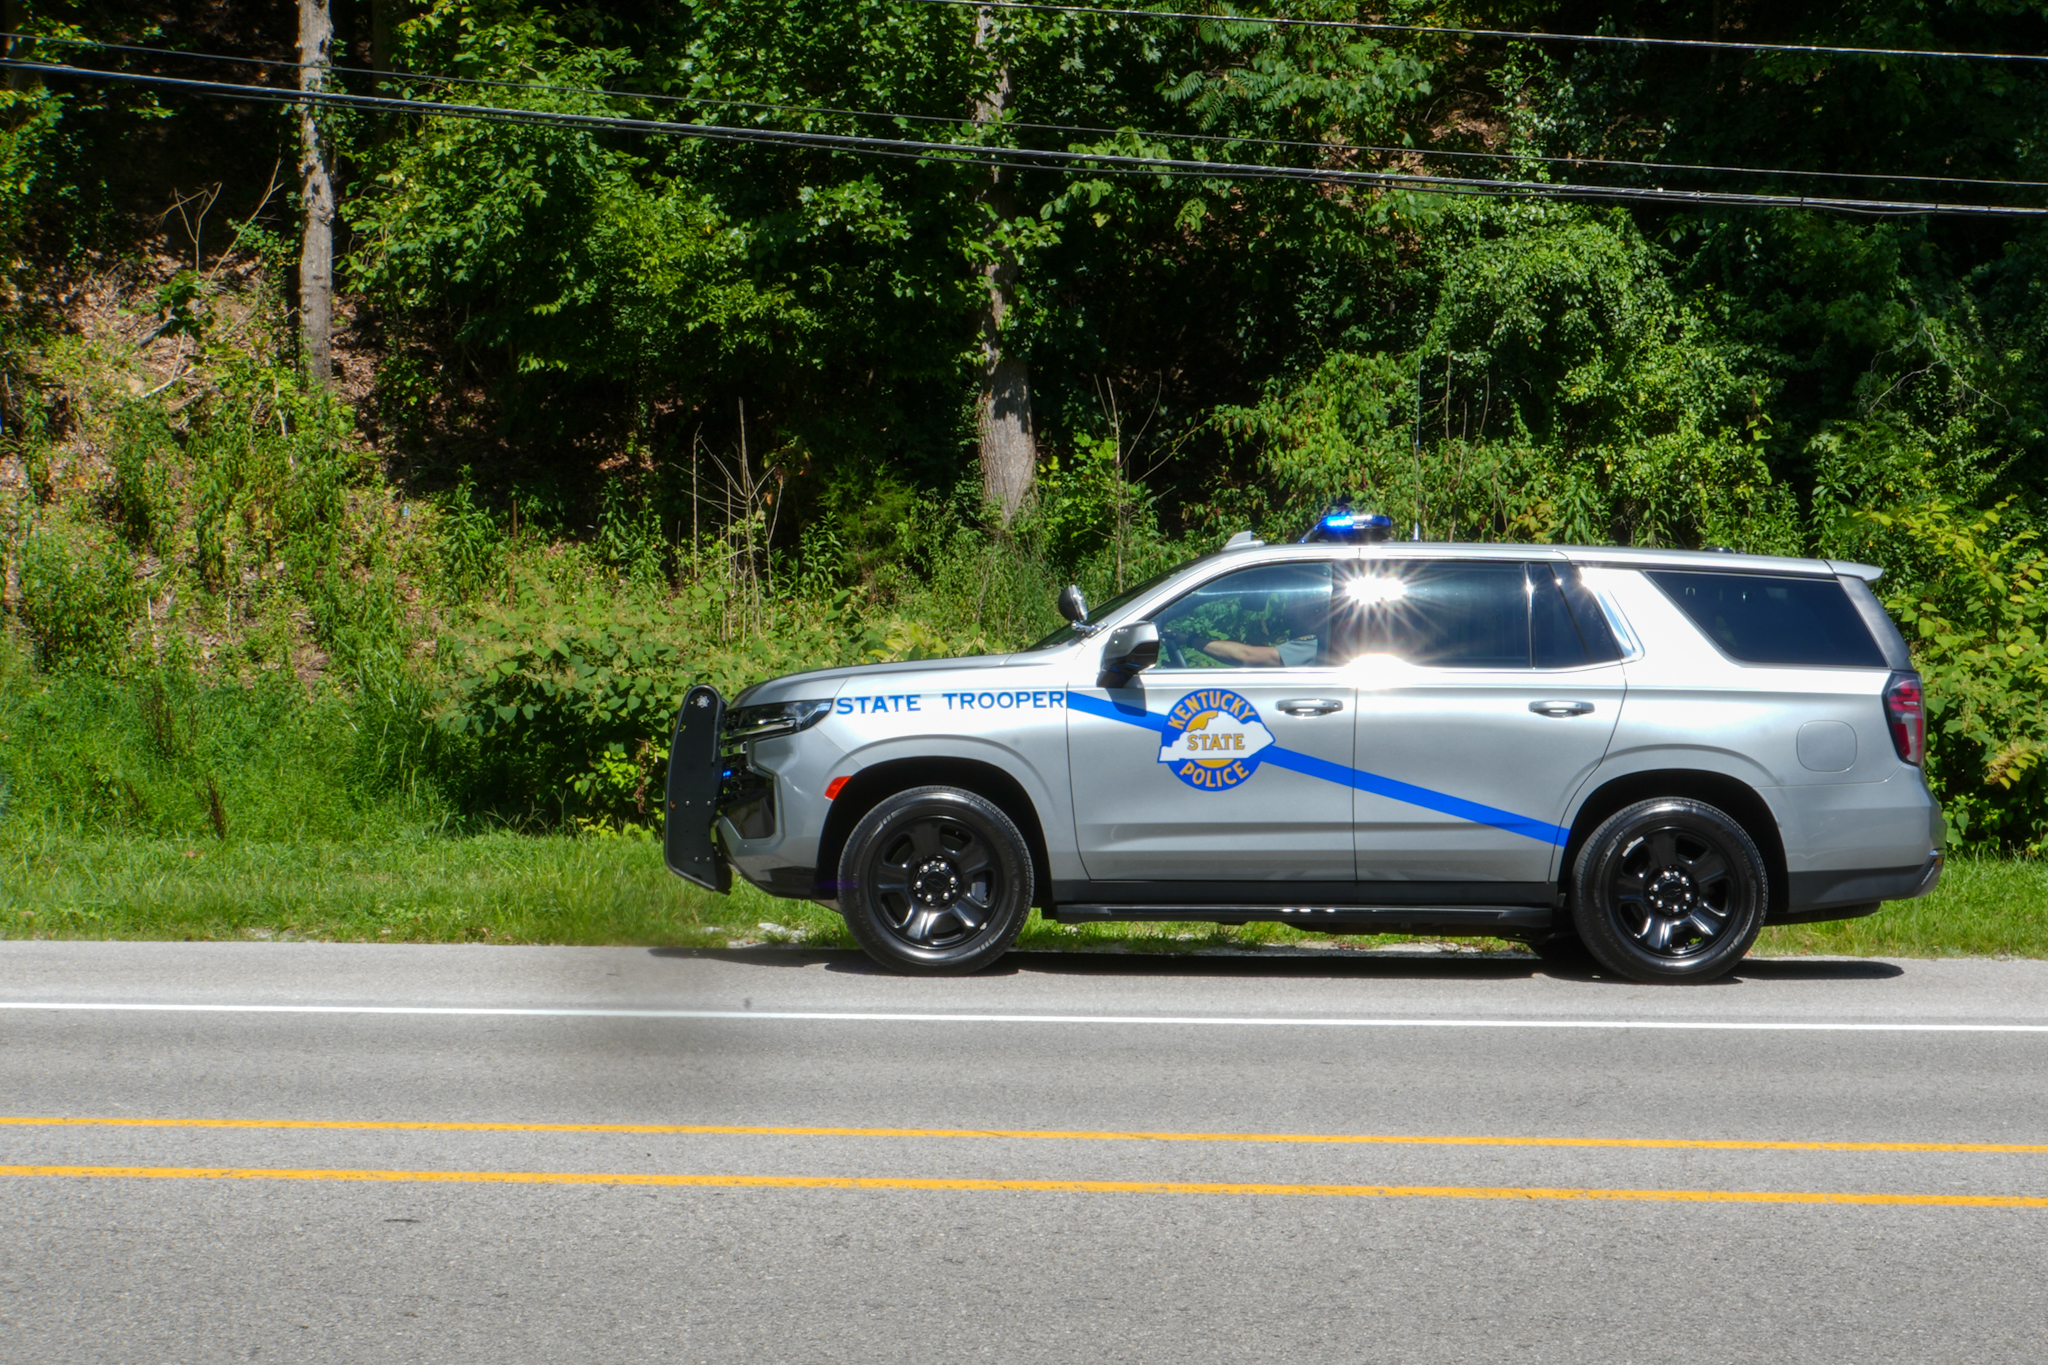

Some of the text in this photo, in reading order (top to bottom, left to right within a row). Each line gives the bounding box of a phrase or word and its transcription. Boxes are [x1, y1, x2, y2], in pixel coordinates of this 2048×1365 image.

[836, 691, 1065, 715] STATE TROOPER
[1168, 691, 1256, 730] KENTUCKY
[1187, 734, 1246, 751] STATE
[1179, 761, 1250, 788] POLICE
